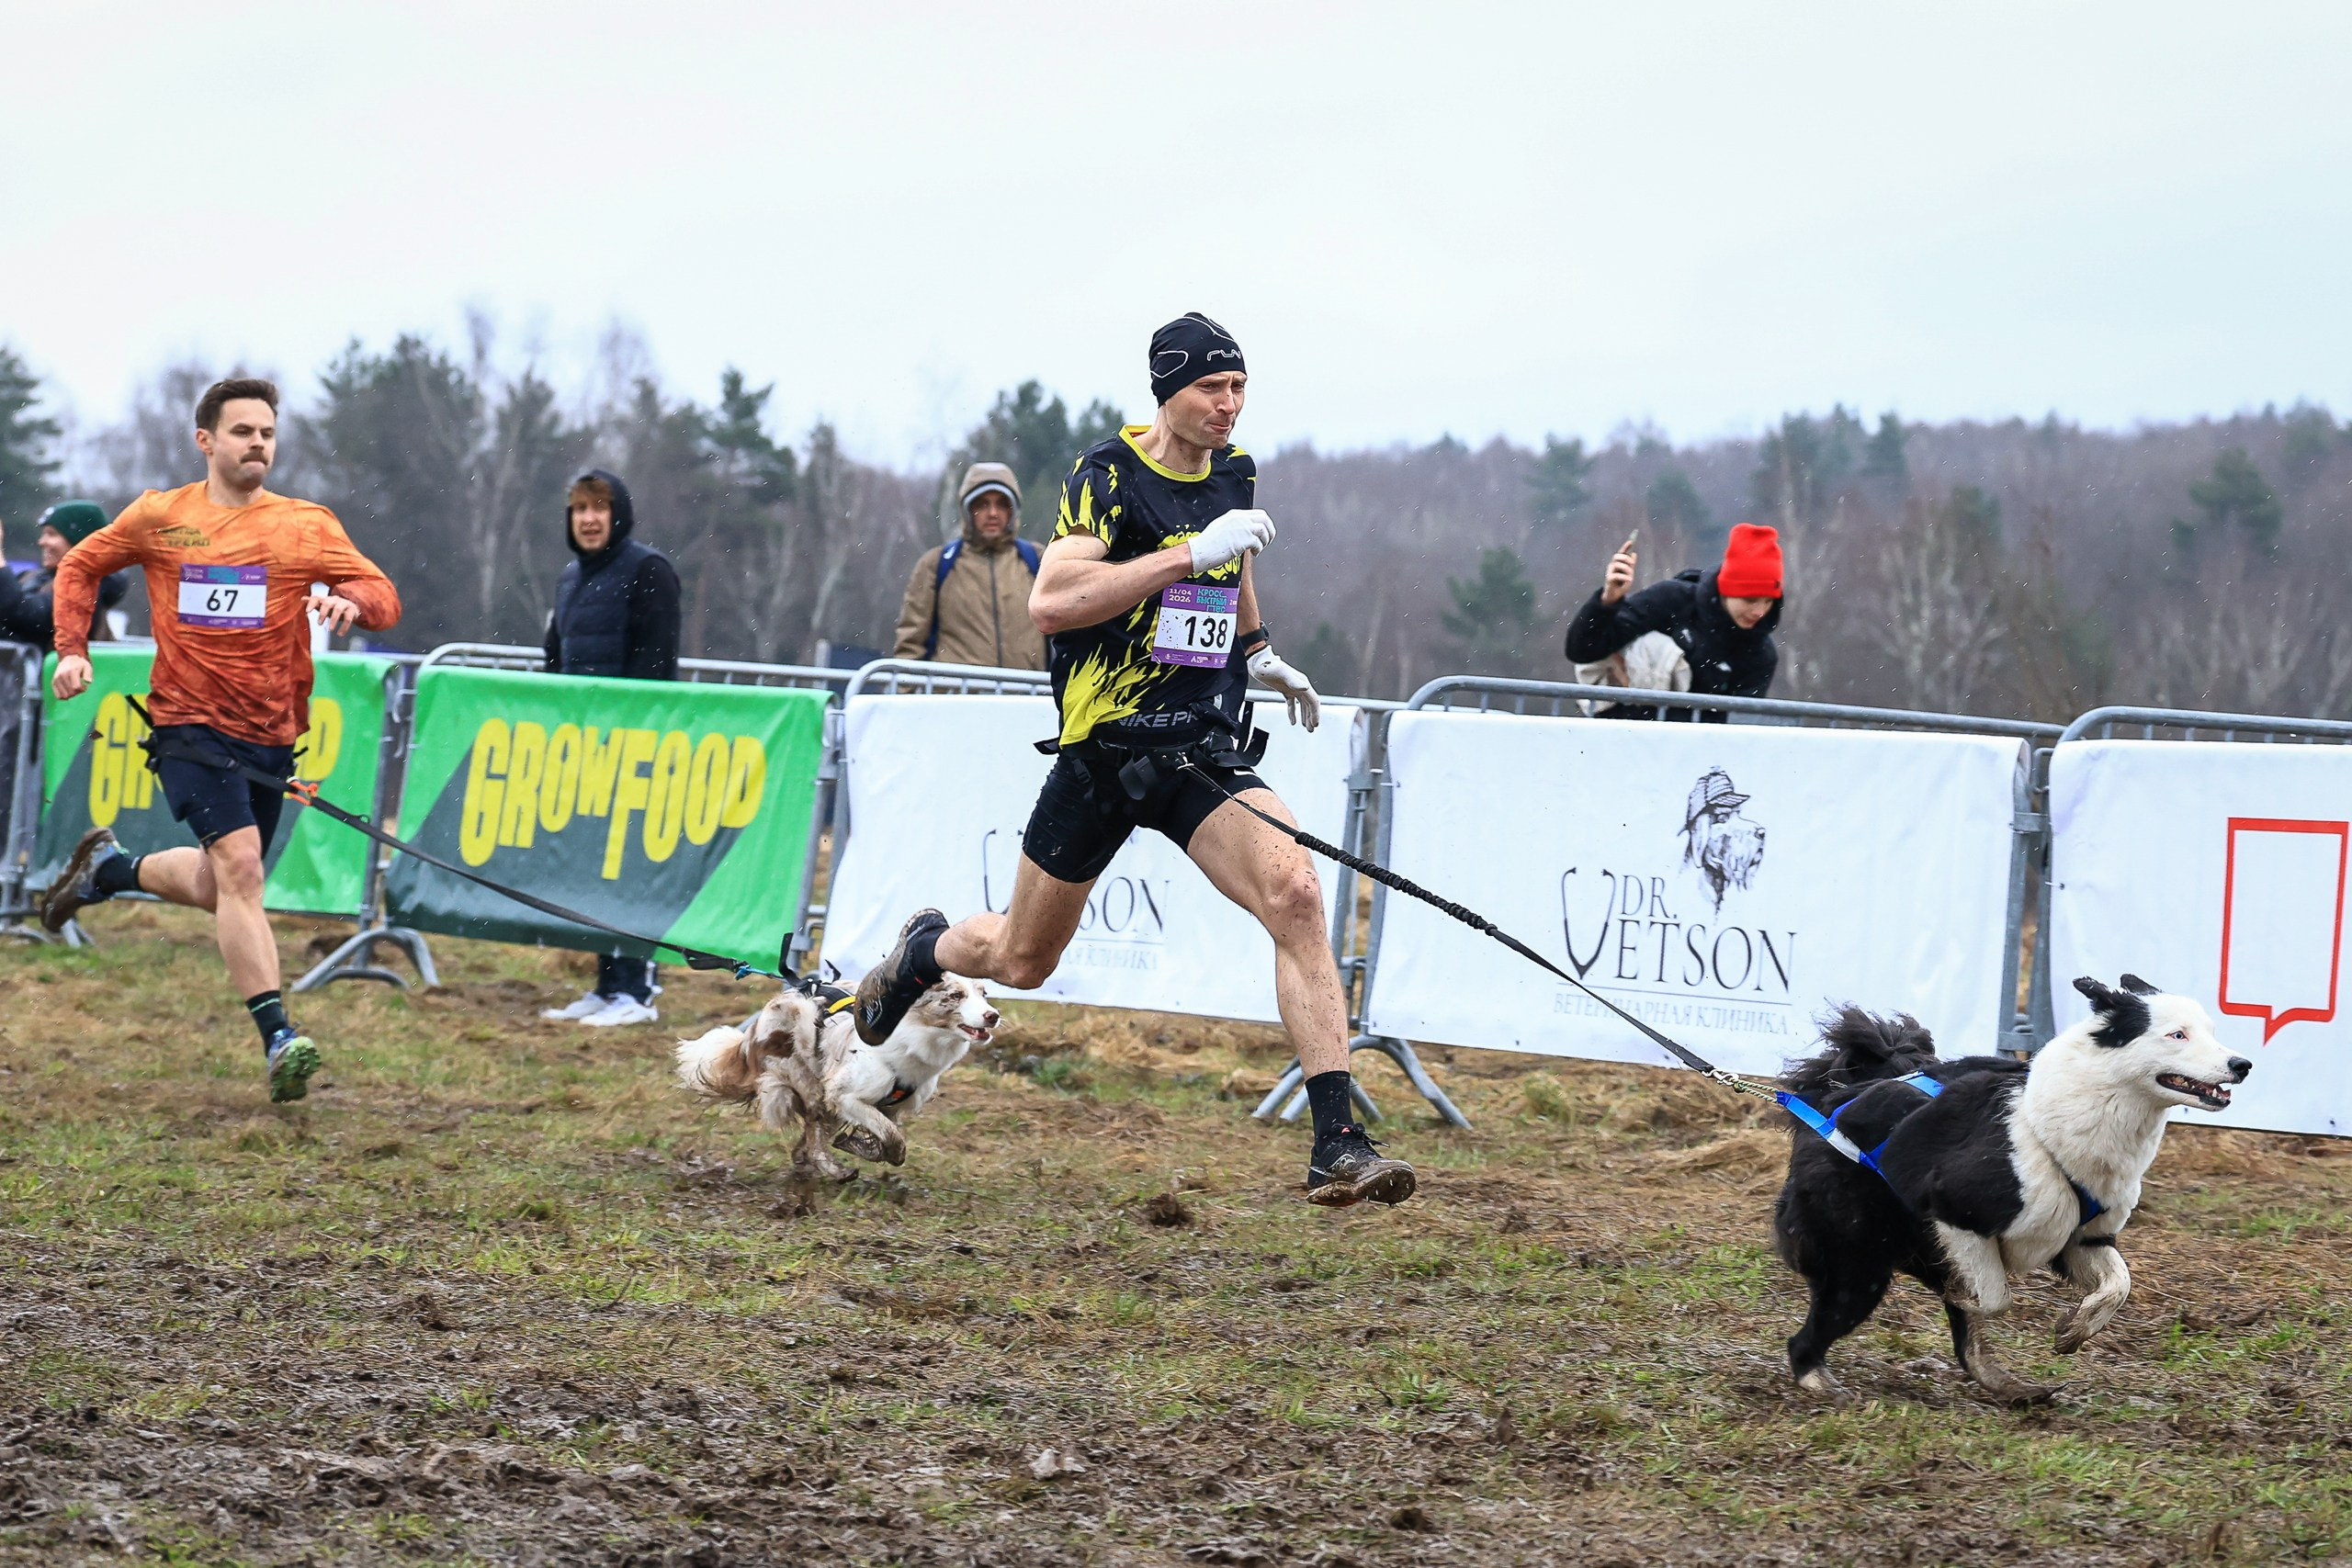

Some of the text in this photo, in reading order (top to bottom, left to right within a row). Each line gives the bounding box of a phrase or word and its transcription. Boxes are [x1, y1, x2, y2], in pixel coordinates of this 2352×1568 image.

[206, 589, 239, 613] 67
[1168, 594, 1192, 604] 2026
[1169, 588, 1193, 596] 11/04
[1184, 615, 1228, 649] 138
[461, 717, 767, 881] GROWFOOD
[1620, 874, 1678, 919] DR.
[1695, 1006, 1790, 1035] КЛИНИКА
